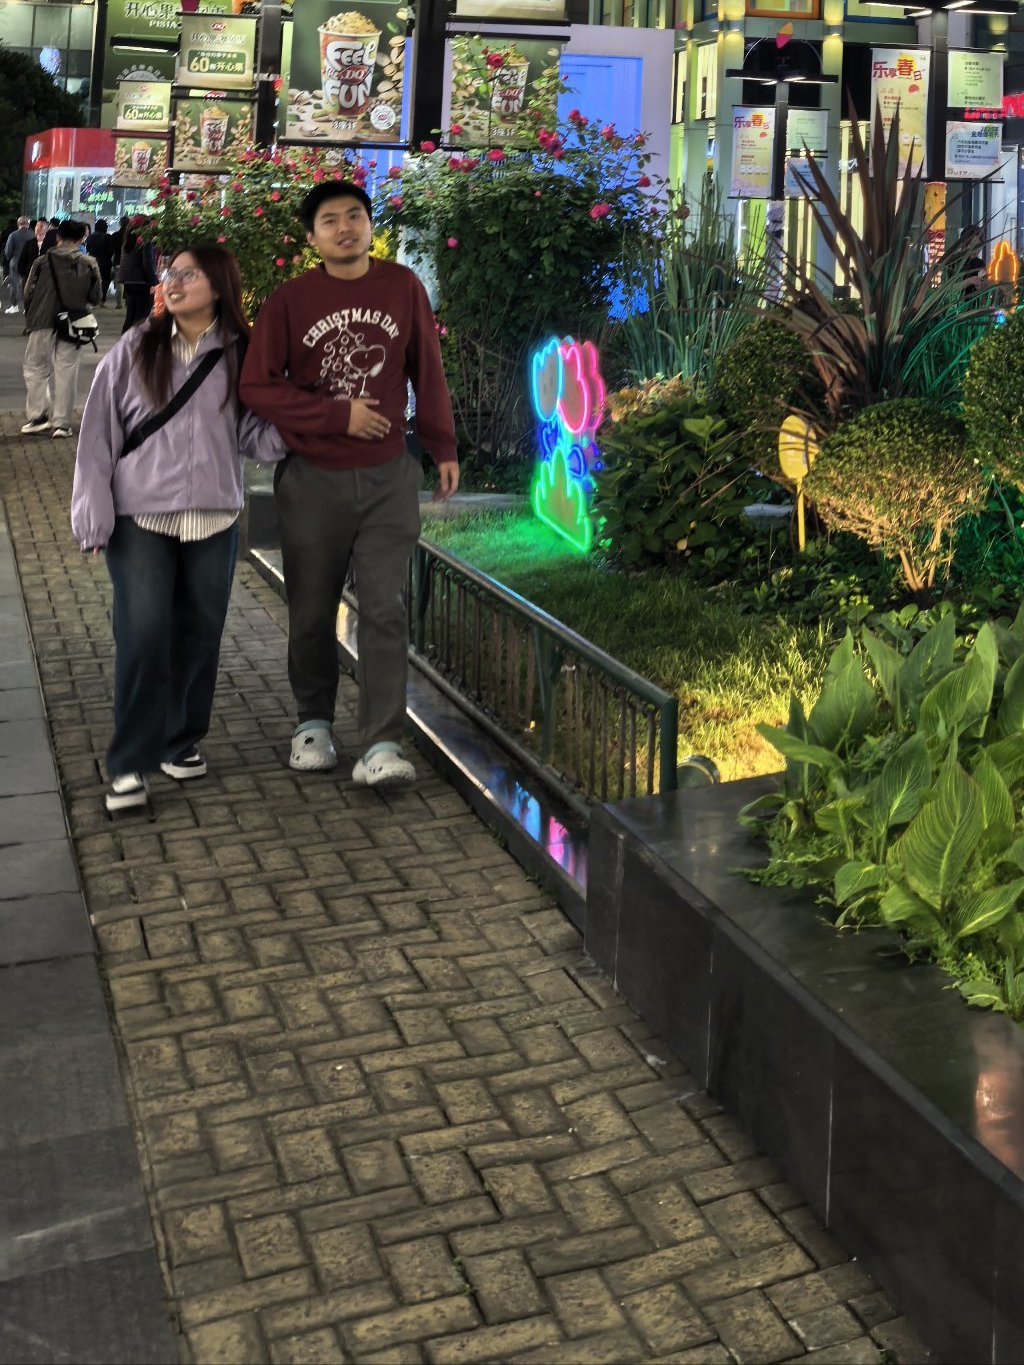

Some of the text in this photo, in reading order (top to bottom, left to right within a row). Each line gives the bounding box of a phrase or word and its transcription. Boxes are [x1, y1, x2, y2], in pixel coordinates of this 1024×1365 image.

[149, 19, 183, 29] PISTA
[302, 307, 400, 348] CHRISTMAS DAY
